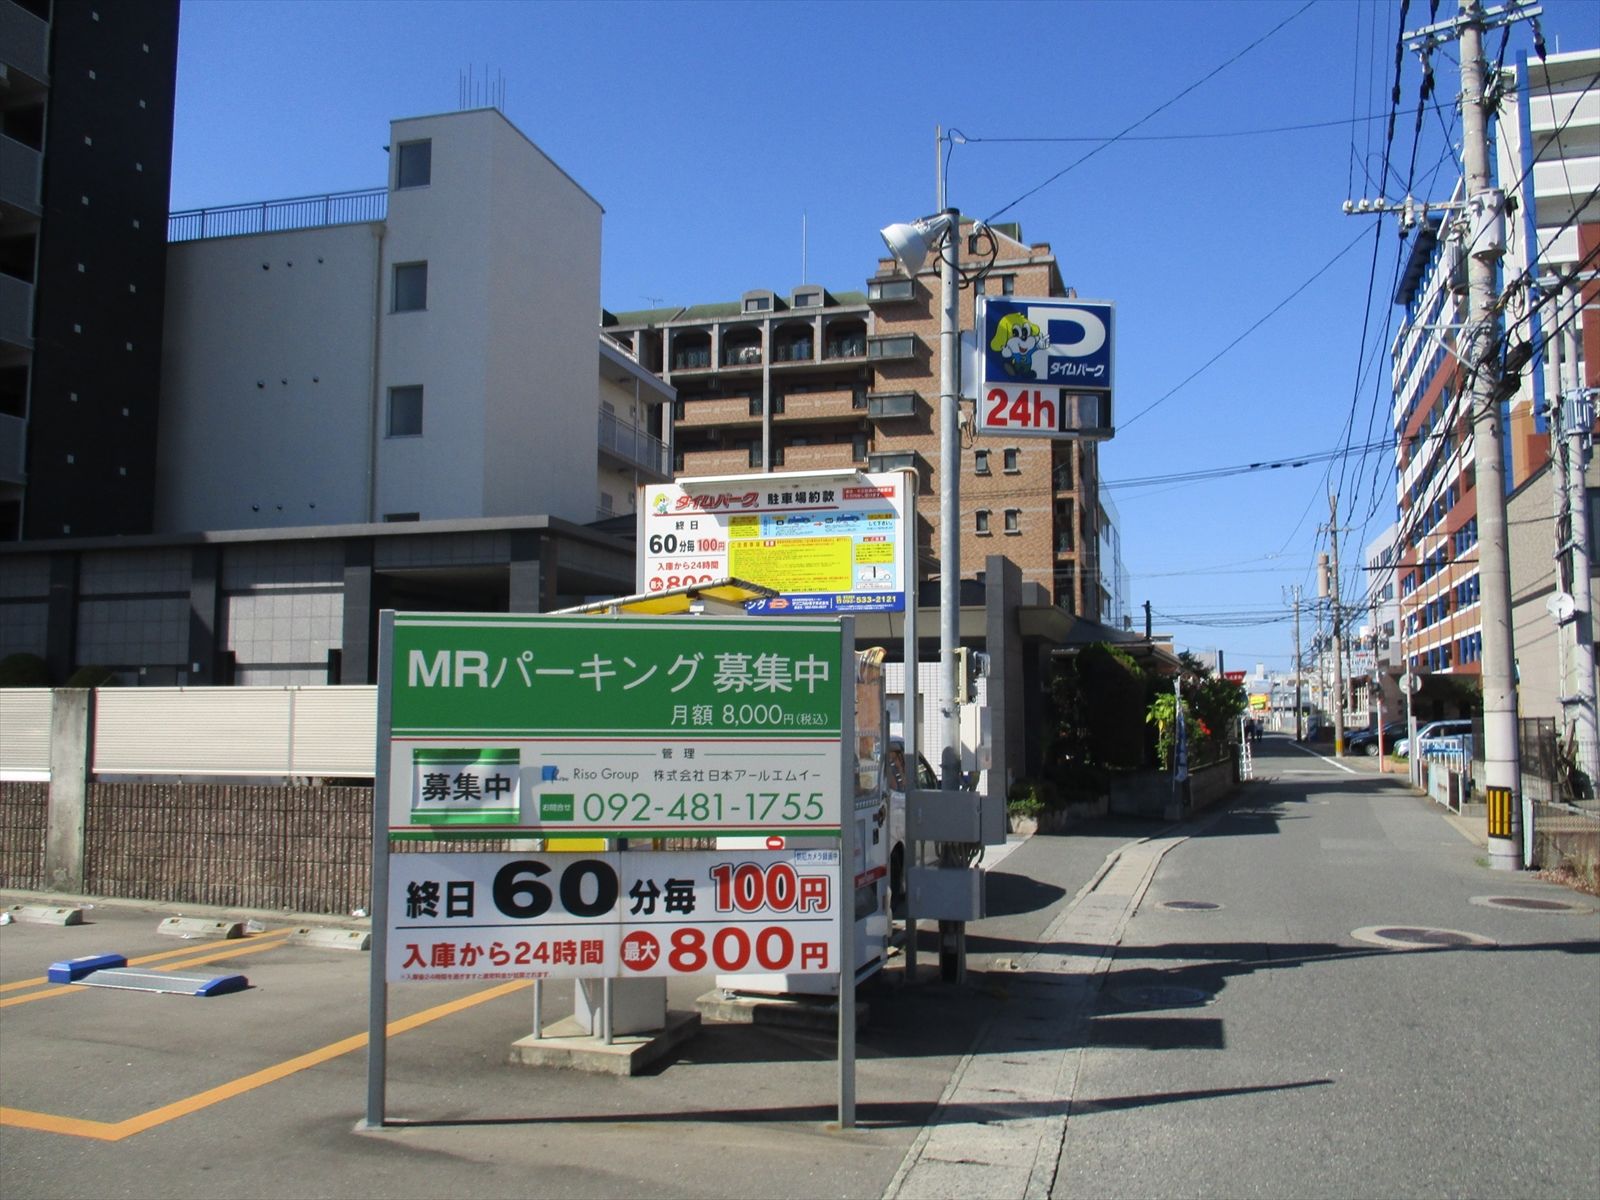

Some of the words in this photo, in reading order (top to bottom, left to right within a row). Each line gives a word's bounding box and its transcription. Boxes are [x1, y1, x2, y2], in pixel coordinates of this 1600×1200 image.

[1028, 307, 1105, 380] P
[1050, 361, 1105, 378] タイムパーク
[986, 388, 1055, 428] 24h
[674, 492, 759, 511] タイムパーク
[767, 490, 835, 505] 駐車場約款
[675, 520, 699, 531] 終日
[697, 538, 726, 552] 100円
[657, 560, 719, 571] 入庫から24時間
[408, 649, 704, 693] MRパーキング
[713, 652, 829, 694] 募集中
[670, 704, 712, 726] 月額
[573, 768, 598, 781] Riso
[601, 768, 639, 783] Group
[653, 768, 822, 782] 株式会社日本アールエムイー
[421, 772, 512, 802] 募集中
[583, 792, 825, 822] 092-481-1755
[405, 880, 475, 919] 終日
[709, 861, 830, 914] 100円
[402, 938, 604, 969] 入庫から24時間
[623, 940, 657, 962] 最大
[668, 926, 829, 973] 800円
